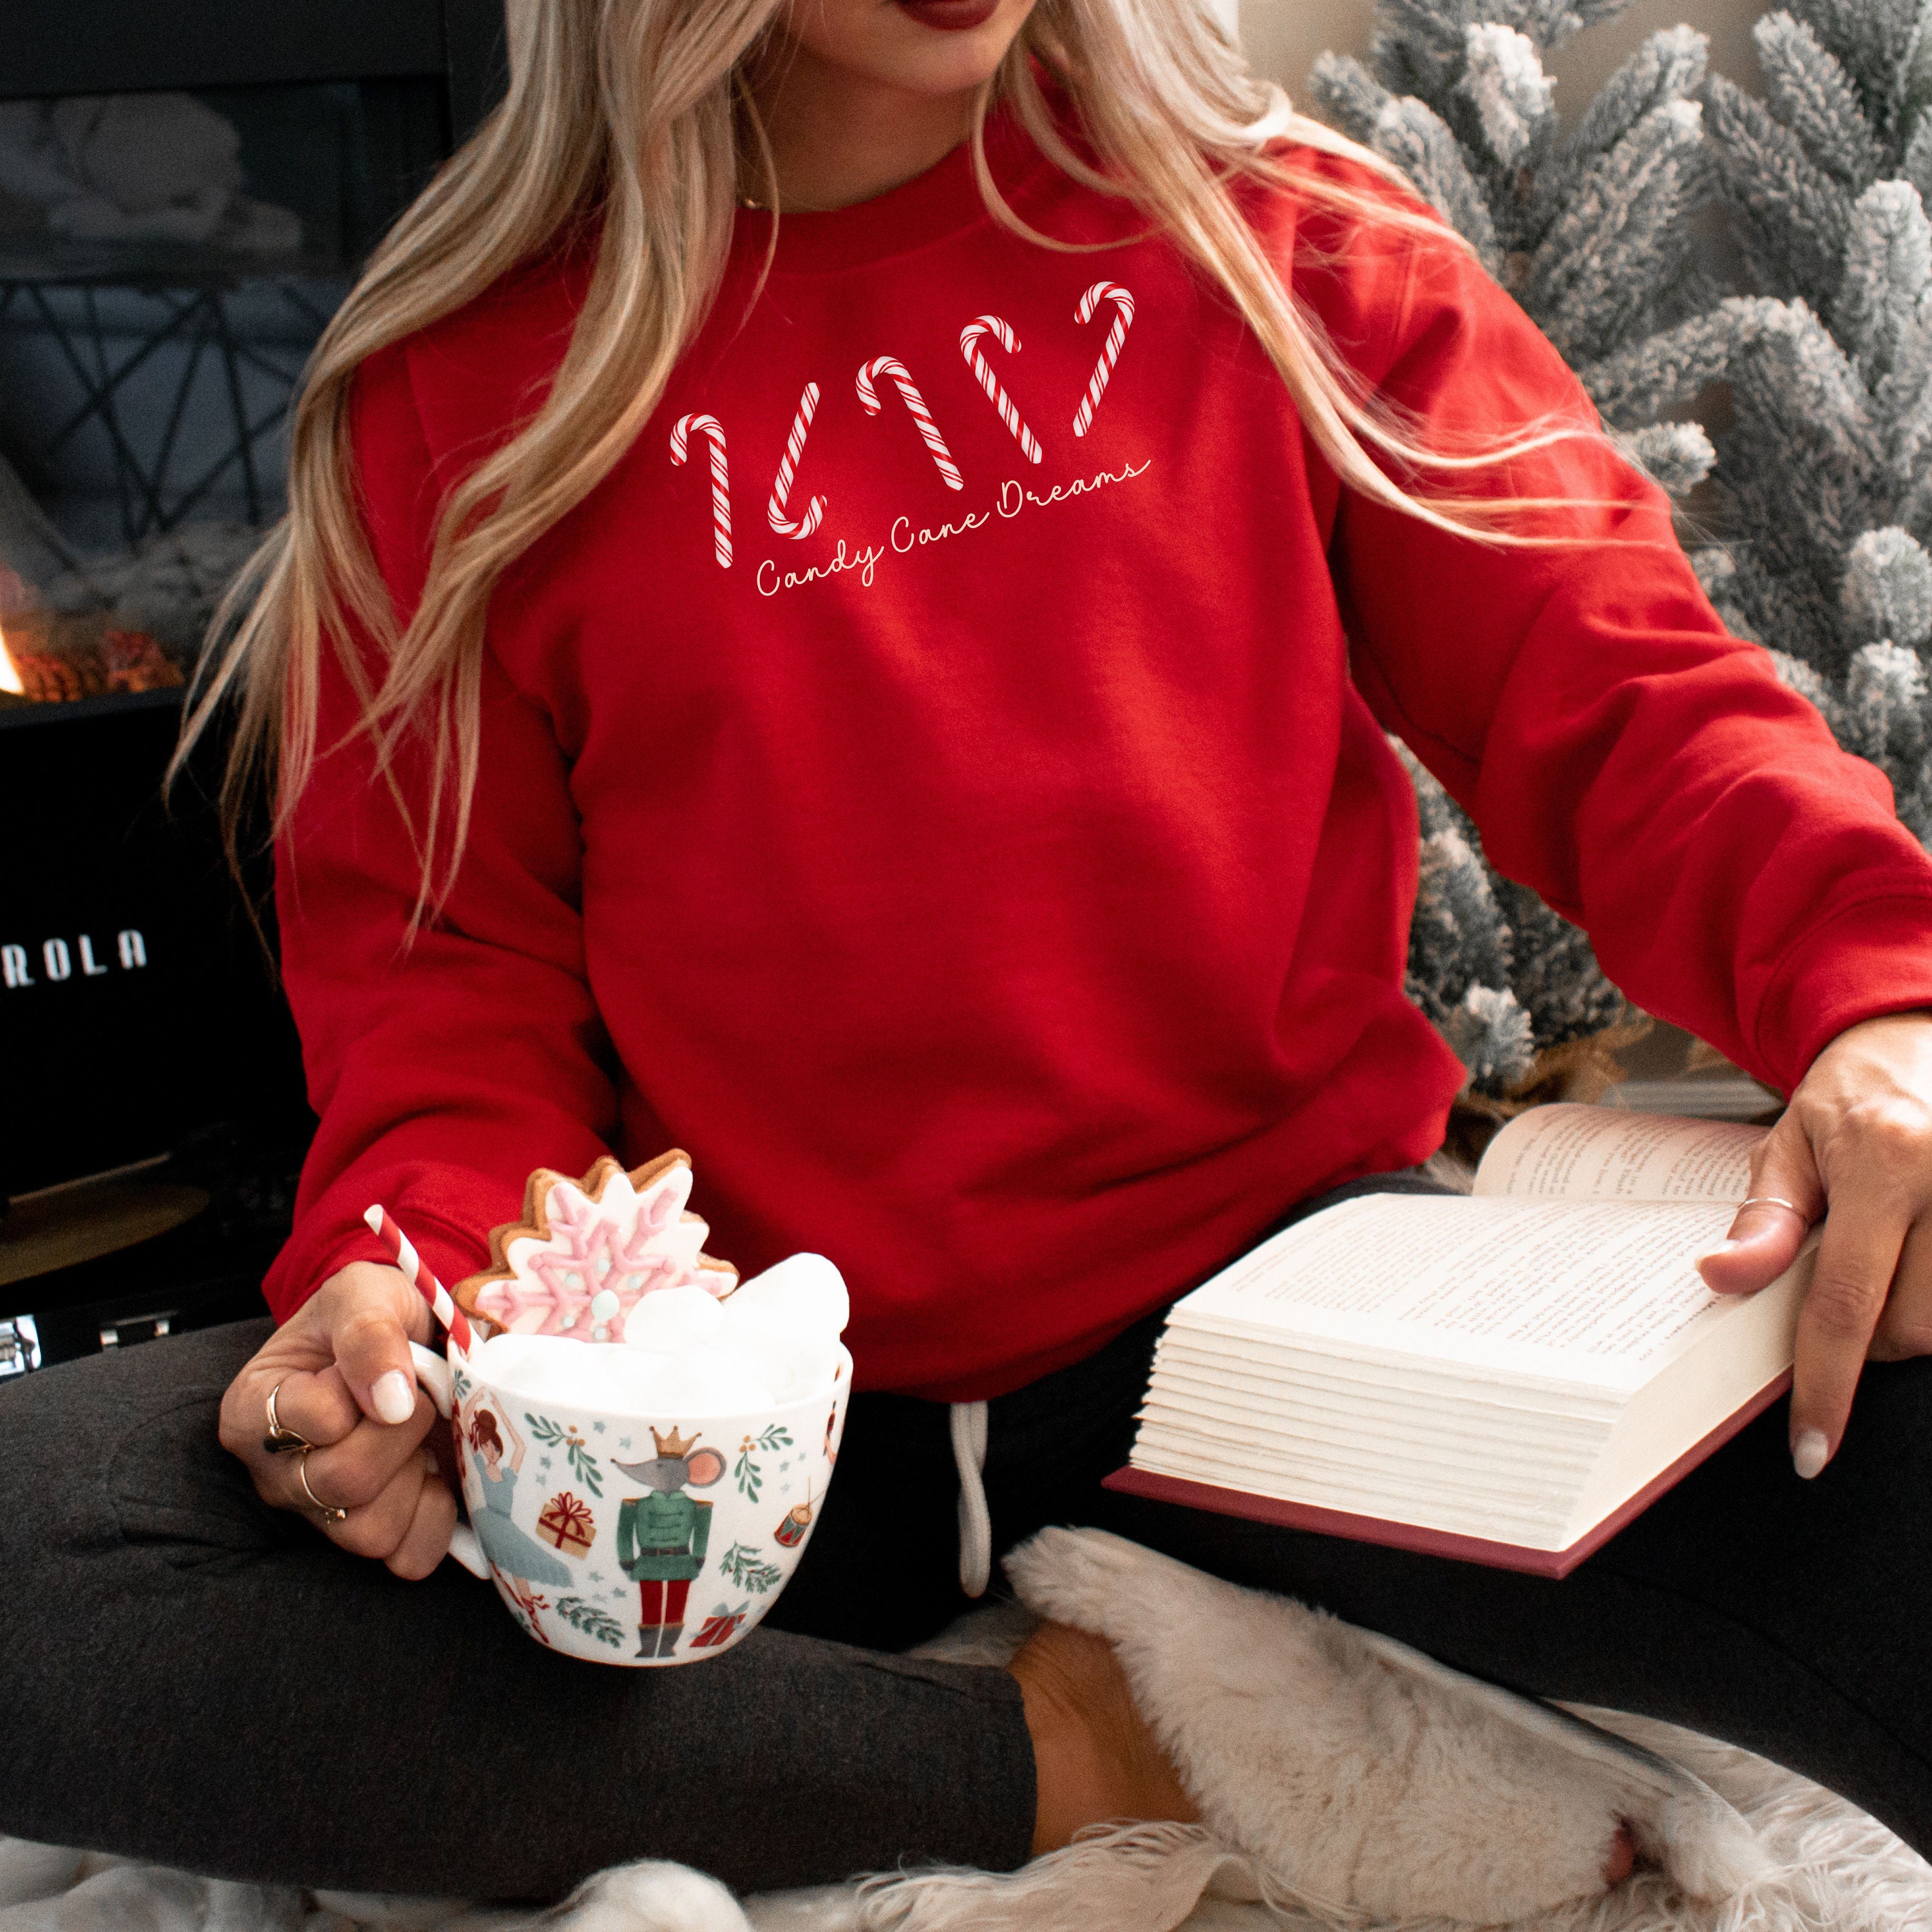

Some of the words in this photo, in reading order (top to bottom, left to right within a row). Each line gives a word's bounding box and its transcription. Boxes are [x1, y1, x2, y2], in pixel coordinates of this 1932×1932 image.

[757, 538, 885, 597] Candy
[891, 511, 990, 553] Cane
[996, 459, 1151, 518] Dreams
[1, 930, 147, 988] ROLA
